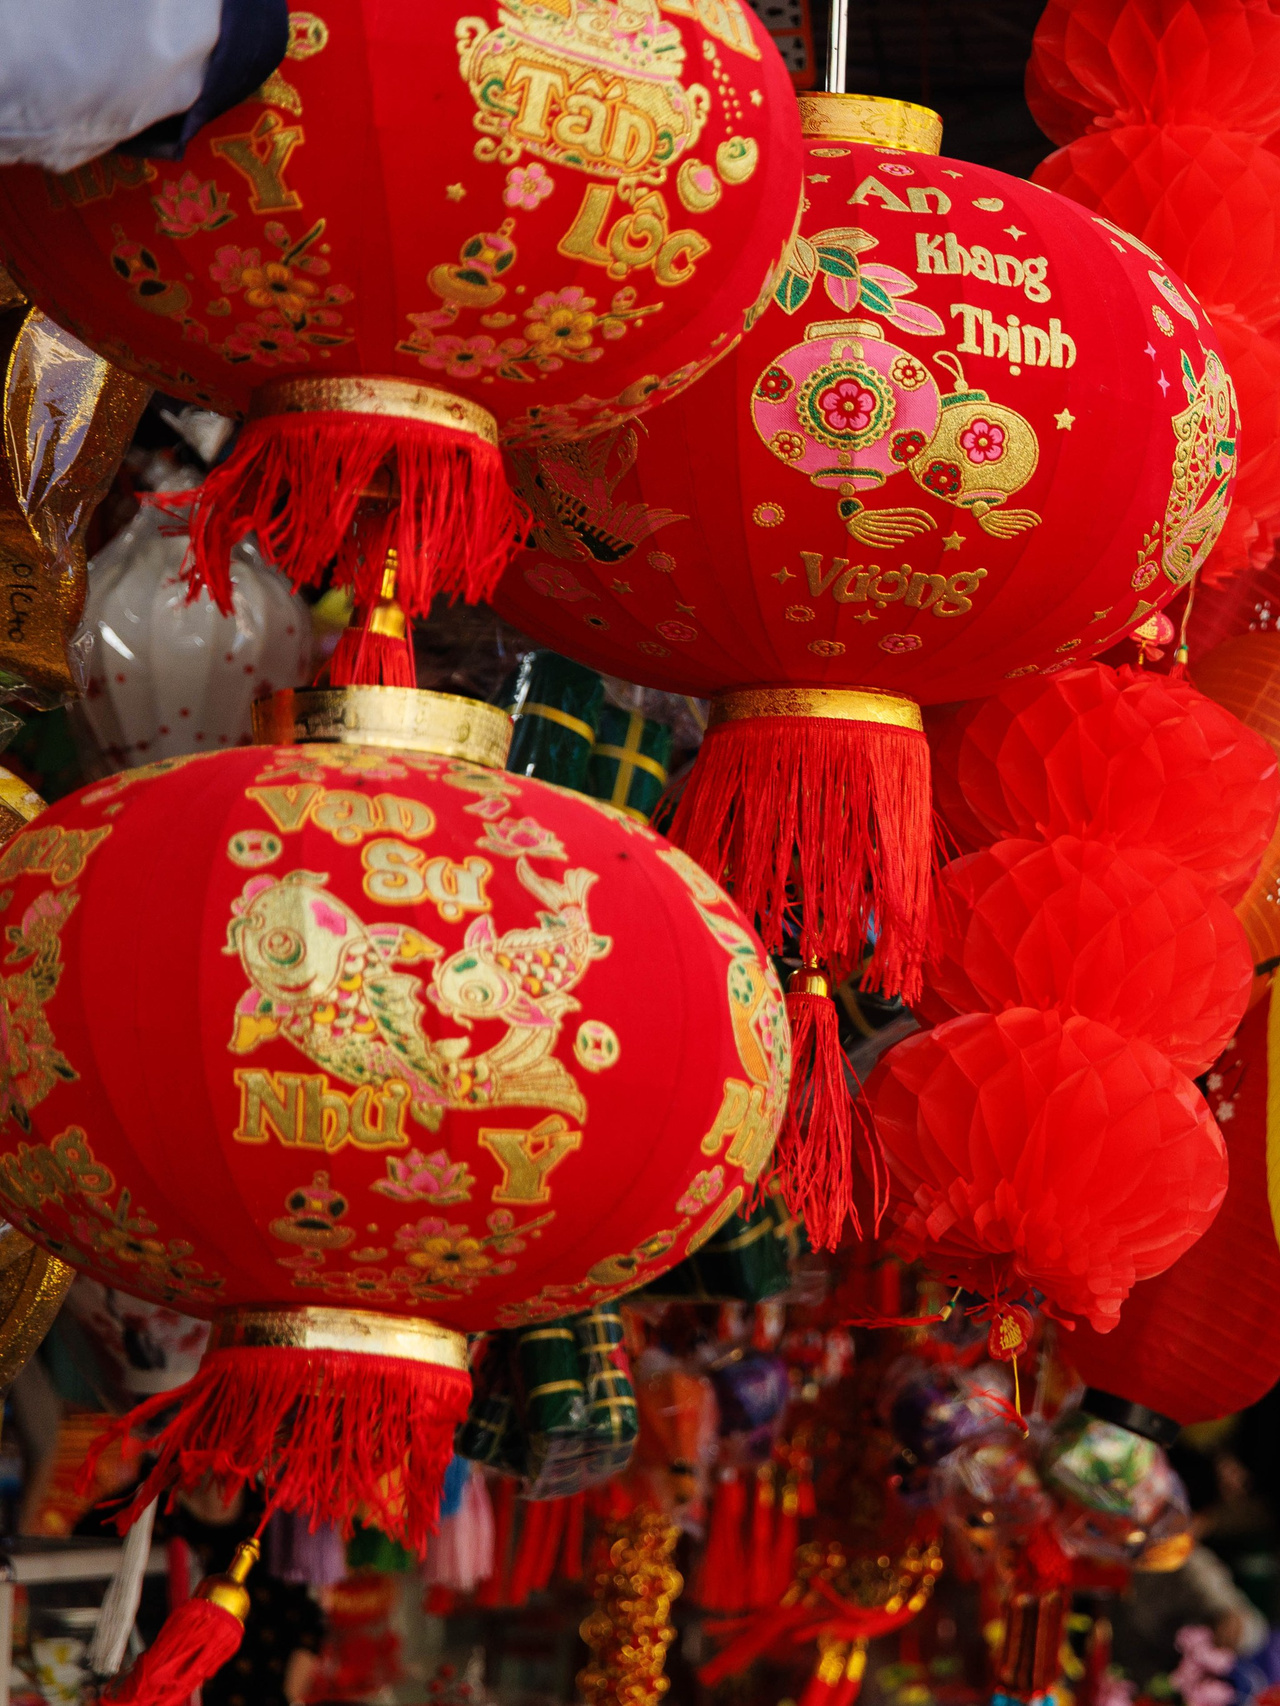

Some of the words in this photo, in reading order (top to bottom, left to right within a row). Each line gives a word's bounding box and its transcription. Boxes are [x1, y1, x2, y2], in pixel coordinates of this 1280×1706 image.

[506, 58, 656, 173] Tấn
[848, 175, 952, 215] An
[557, 183, 711, 287] Lộc
[916, 232, 1052, 303] Khang
[950, 303, 1077, 376] Thịnh
[799, 550, 988, 617] Vượng
[245, 782, 437, 847] Vạn
[360, 837, 494, 923] Sự
[233, 1067, 410, 1154] Như
[477, 1113, 583, 1206] Ý
